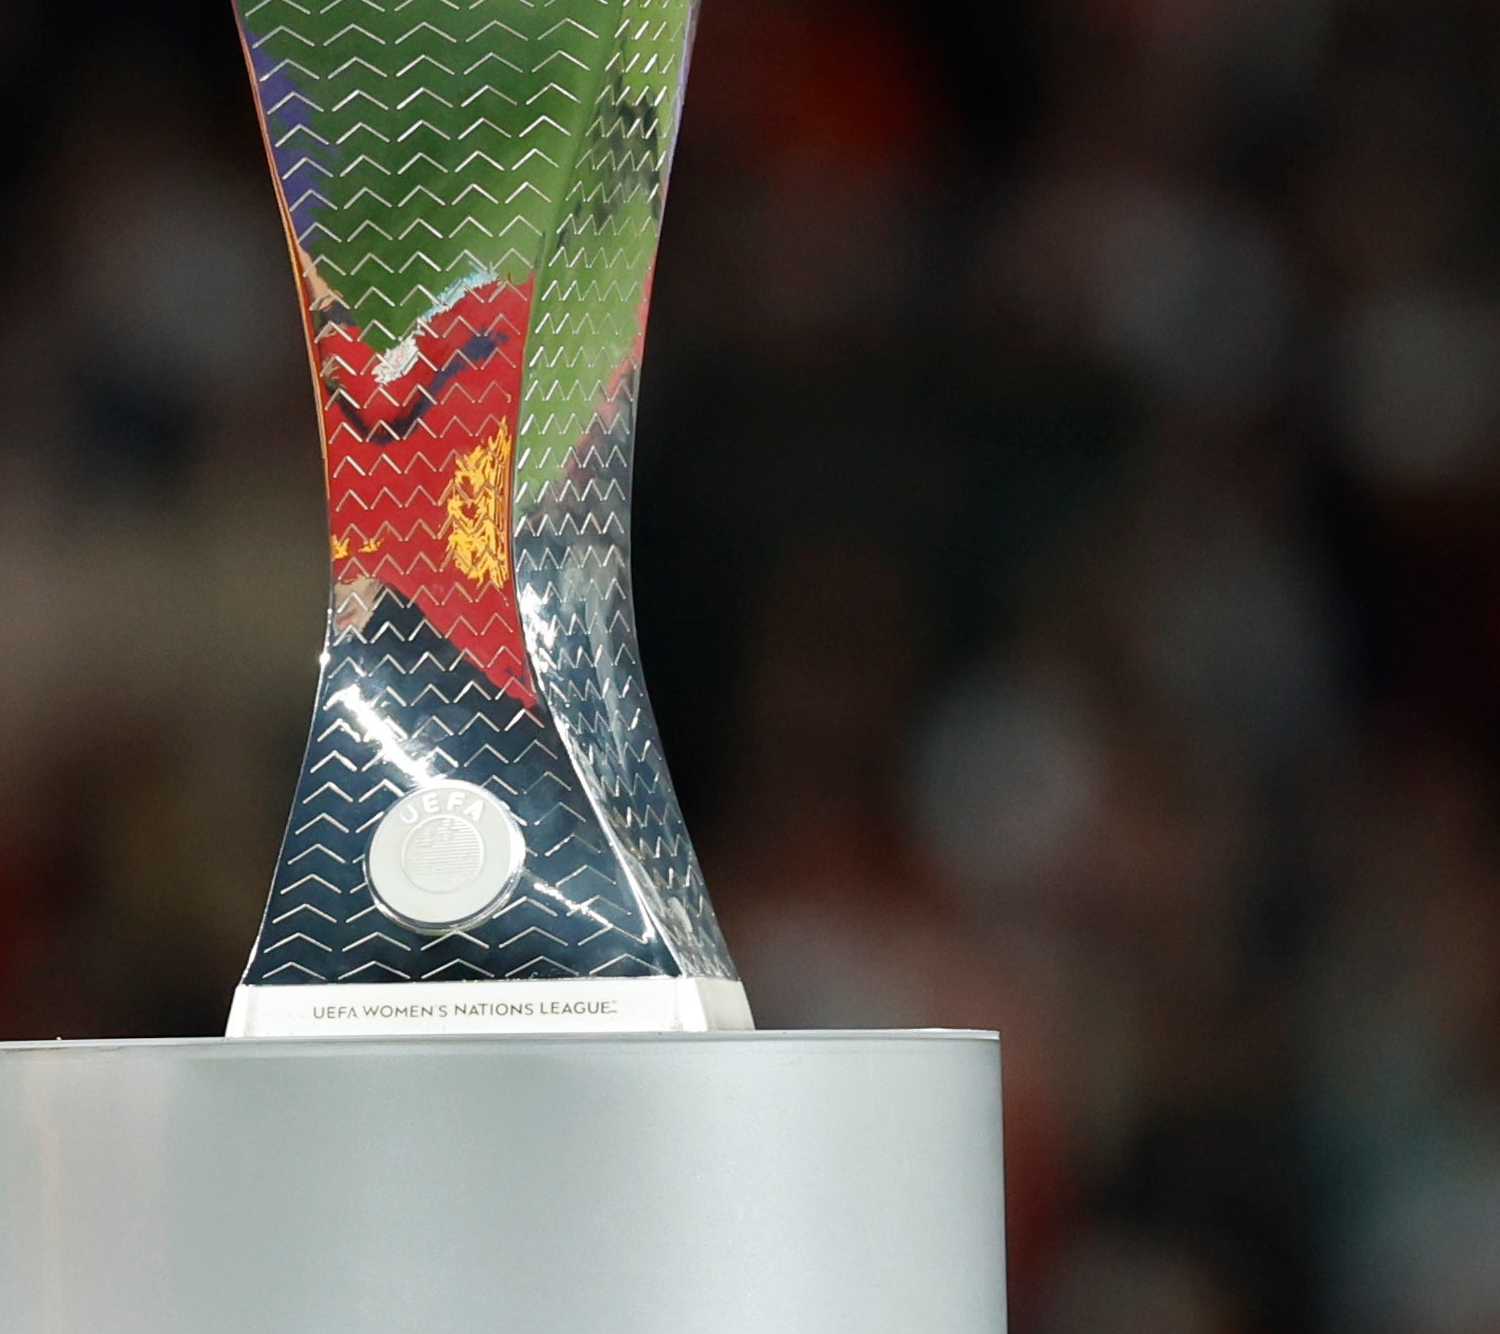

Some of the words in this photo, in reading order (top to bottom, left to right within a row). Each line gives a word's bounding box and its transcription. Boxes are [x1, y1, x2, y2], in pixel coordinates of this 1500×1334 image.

[400, 792, 484, 824] UEFA
[313, 1006, 358, 1019] UEFA
[363, 1004, 448, 1018] WOMEN'S
[454, 1002, 534, 1016] NATIONS
